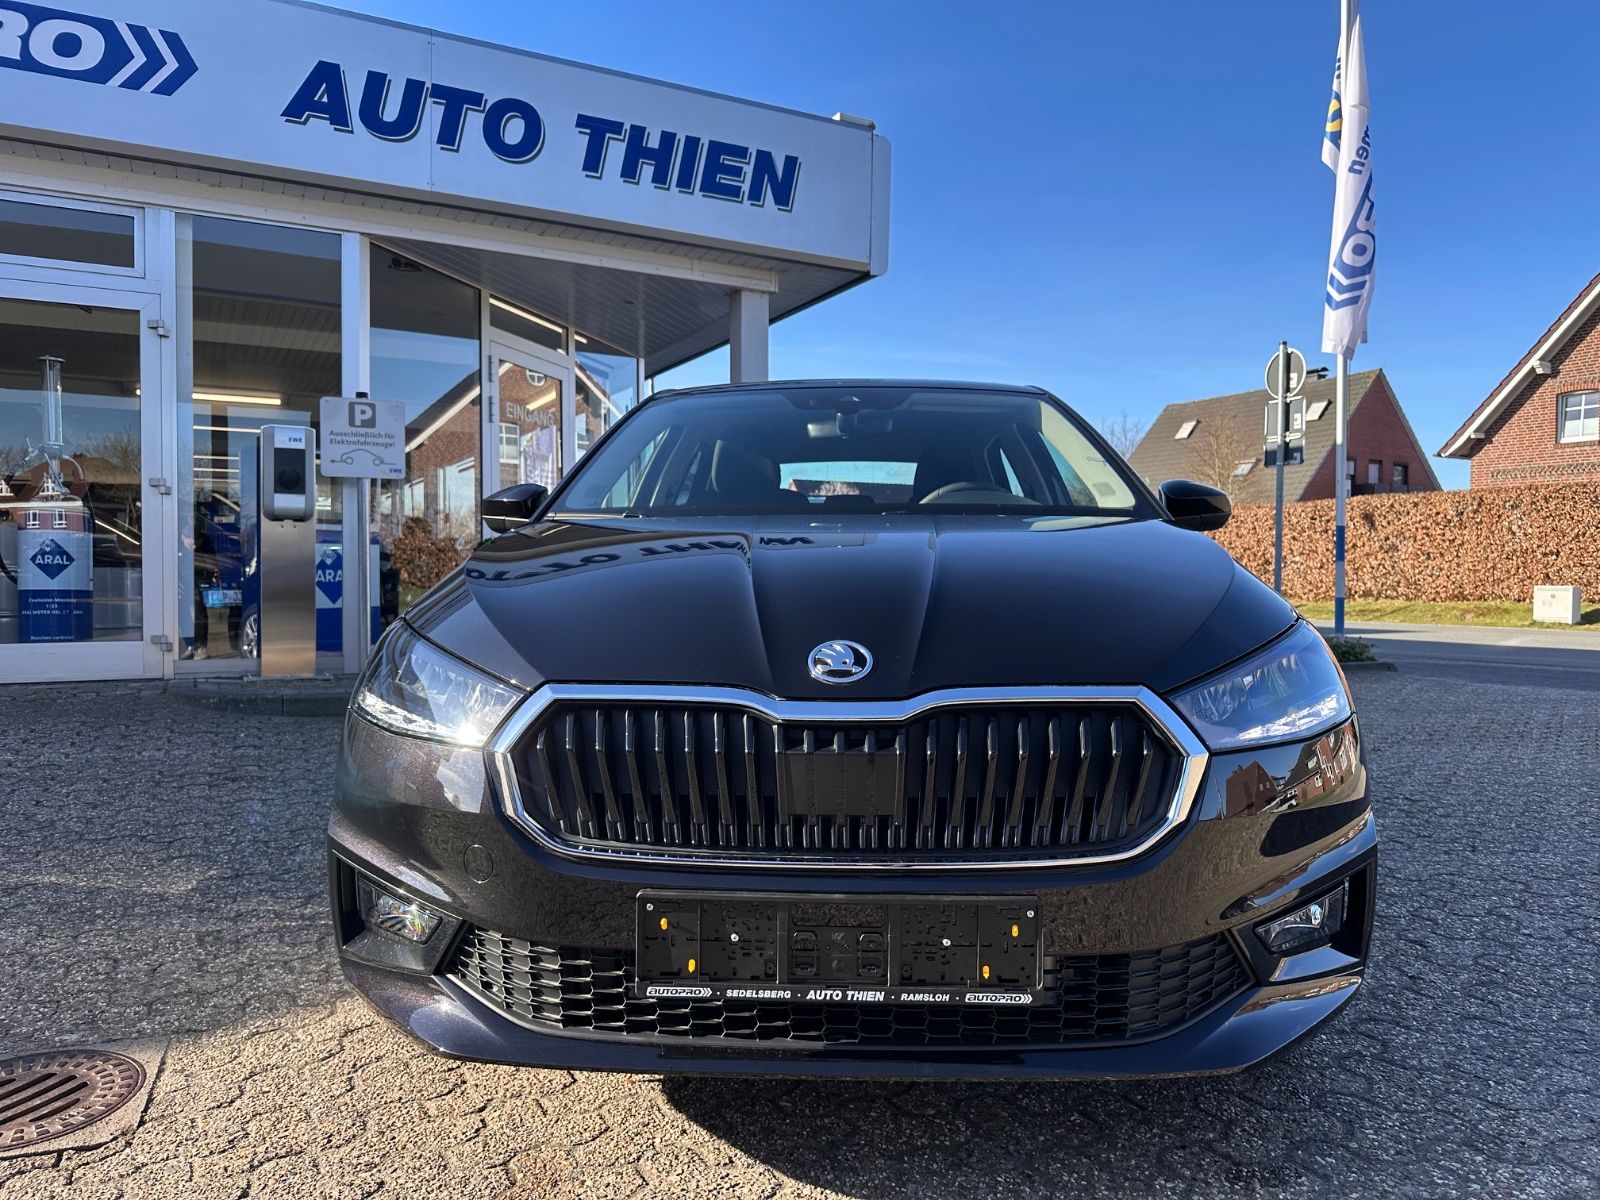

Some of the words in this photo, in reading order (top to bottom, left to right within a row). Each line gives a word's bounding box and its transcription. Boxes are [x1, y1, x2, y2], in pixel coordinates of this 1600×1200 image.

[280, 60, 544, 163] AUTO
[575, 113, 800, 212] THIEN
[354, 404, 373, 426] P
[505, 401, 555, 426] EINGANG
[329, 430, 383, 439] Ausschließlich
[384, 431, 395, 440] für
[329, 438, 396, 449] Elektrofahrzeuge!
[35, 555, 70, 564] ARAL
[726, 989, 791, 998] SEDELSBERG
[806, 990, 842, 1000] AUTO
[846, 991, 885, 1001] THIEN
[900, 993, 950, 1001] RAMSLOH
